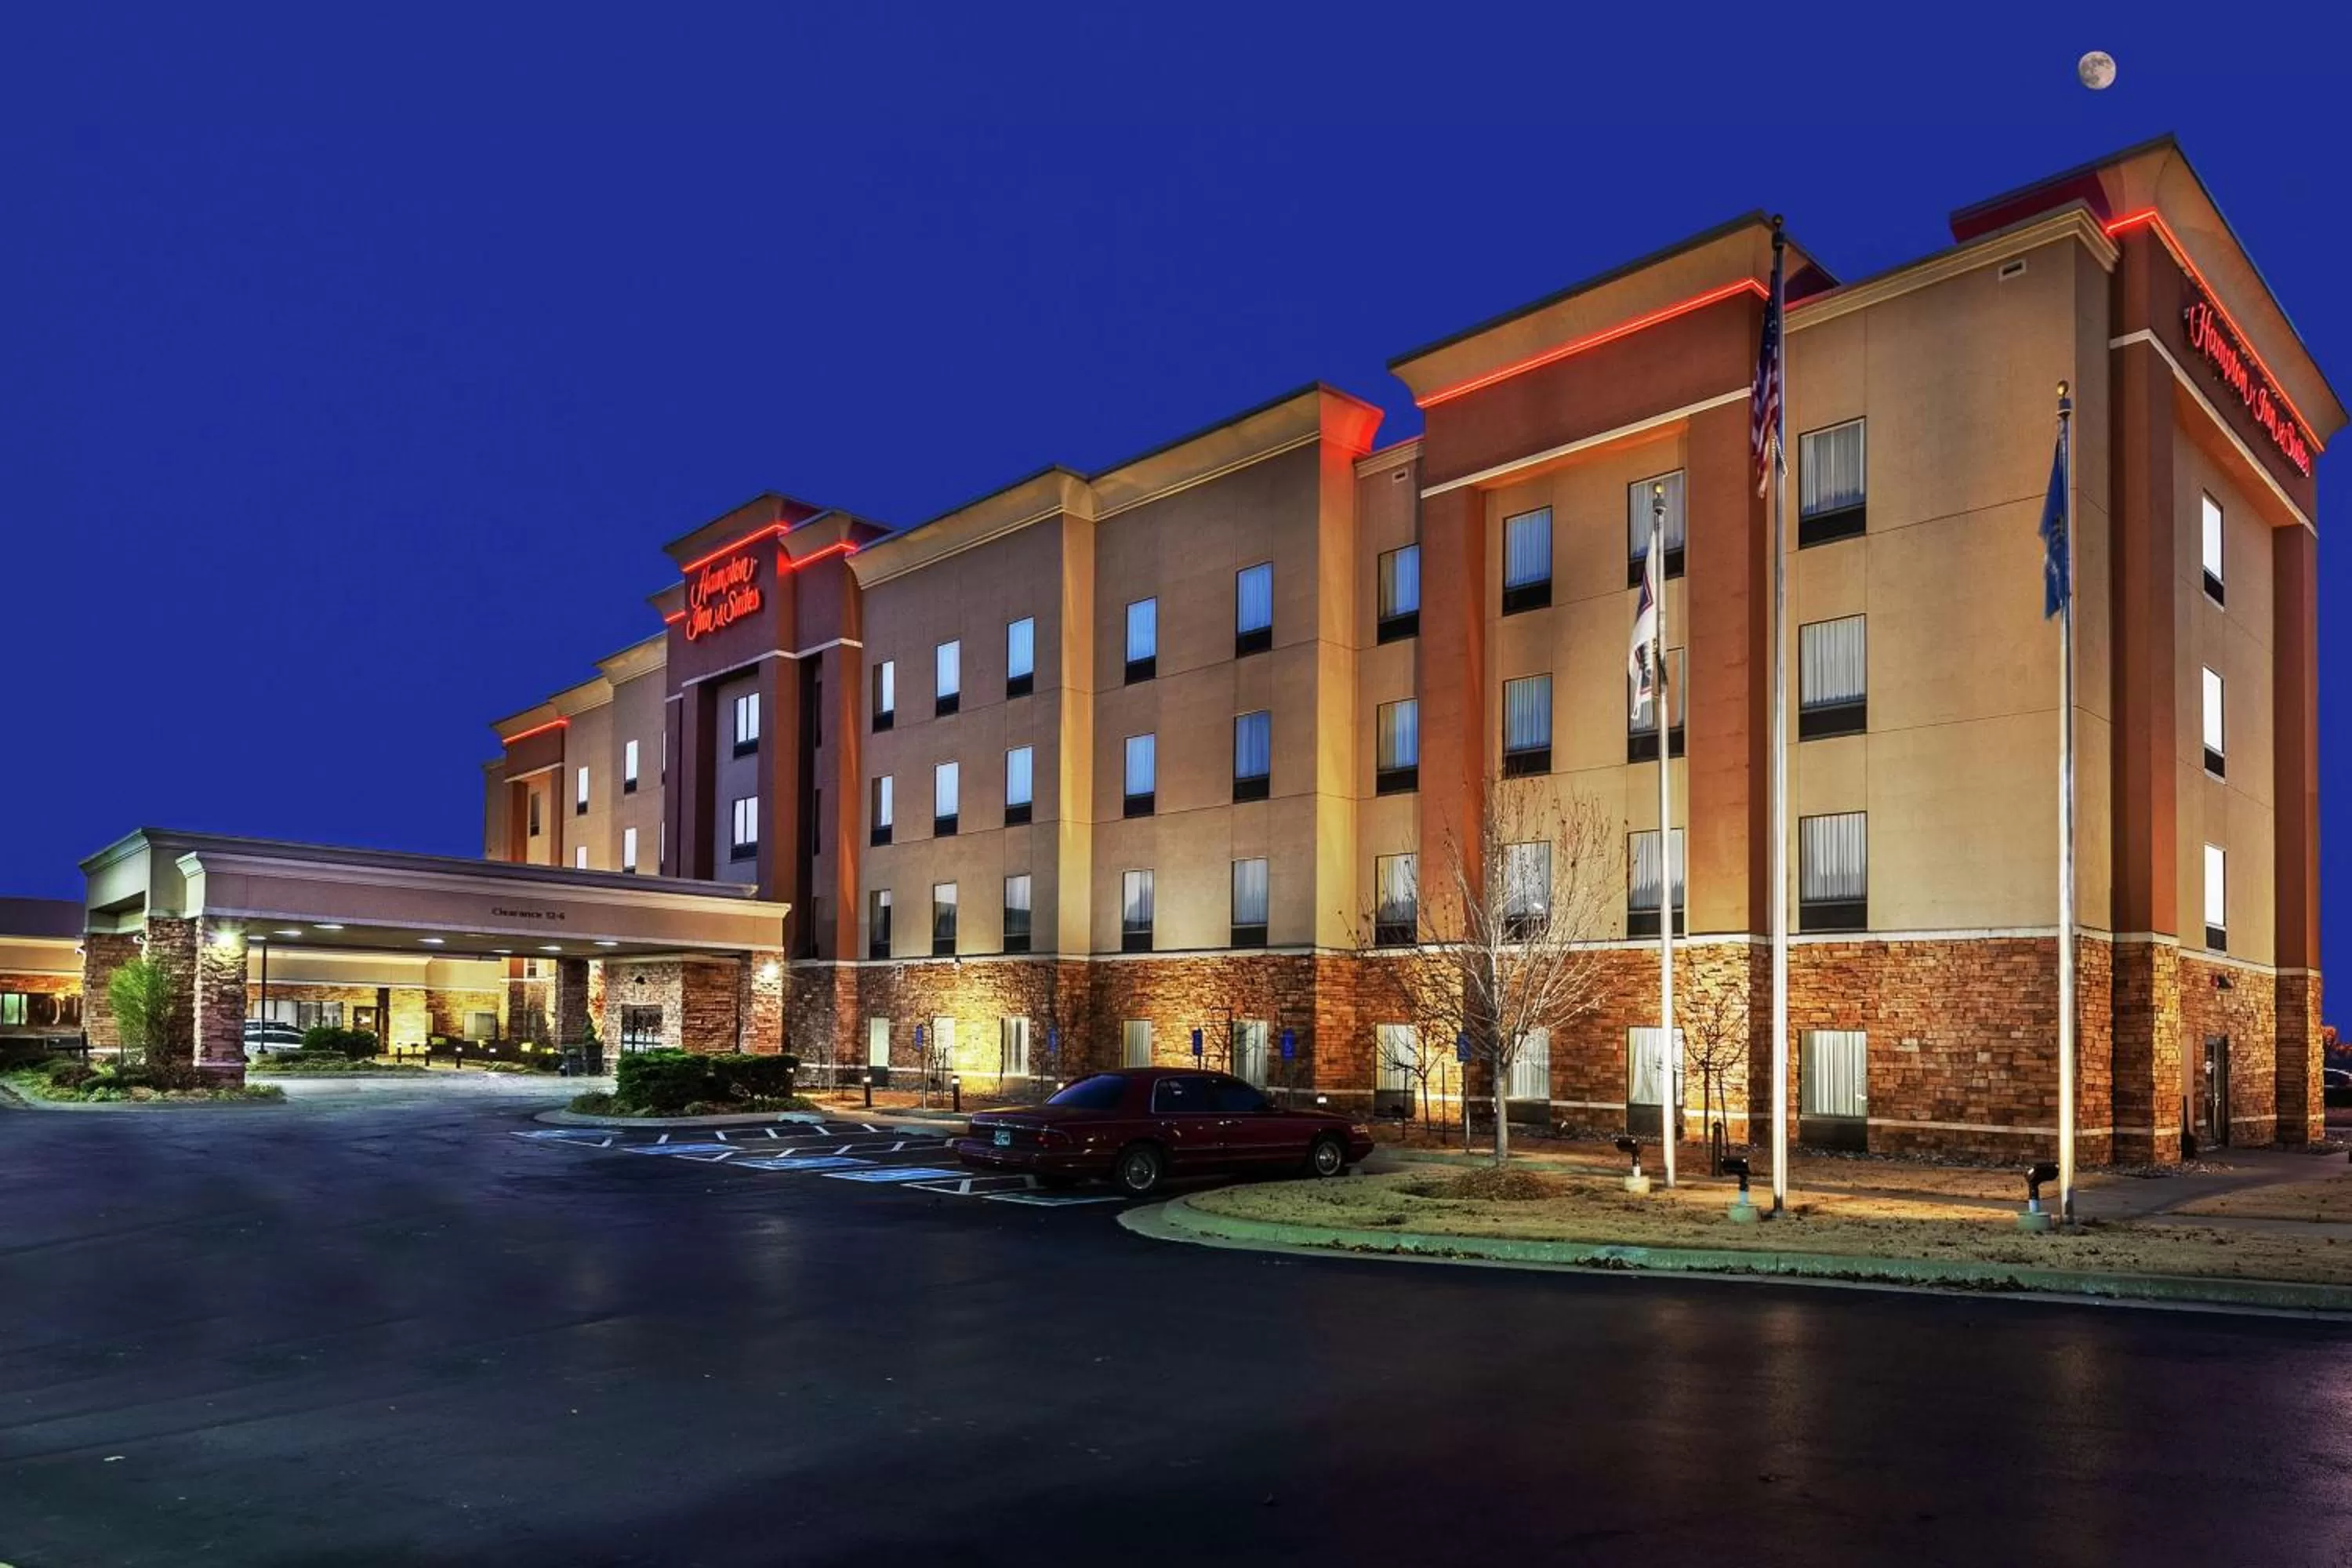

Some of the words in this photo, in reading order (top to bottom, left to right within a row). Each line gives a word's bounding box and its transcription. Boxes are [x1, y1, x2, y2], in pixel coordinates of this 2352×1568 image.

[2190, 302, 2252, 405] Hampton
[2252, 388, 2281, 441] Inn
[690, 556, 753, 608] Hampton
[686, 604, 717, 641] Inn
[724, 586, 760, 622] Suites
[491, 906, 543, 919] Clearance
